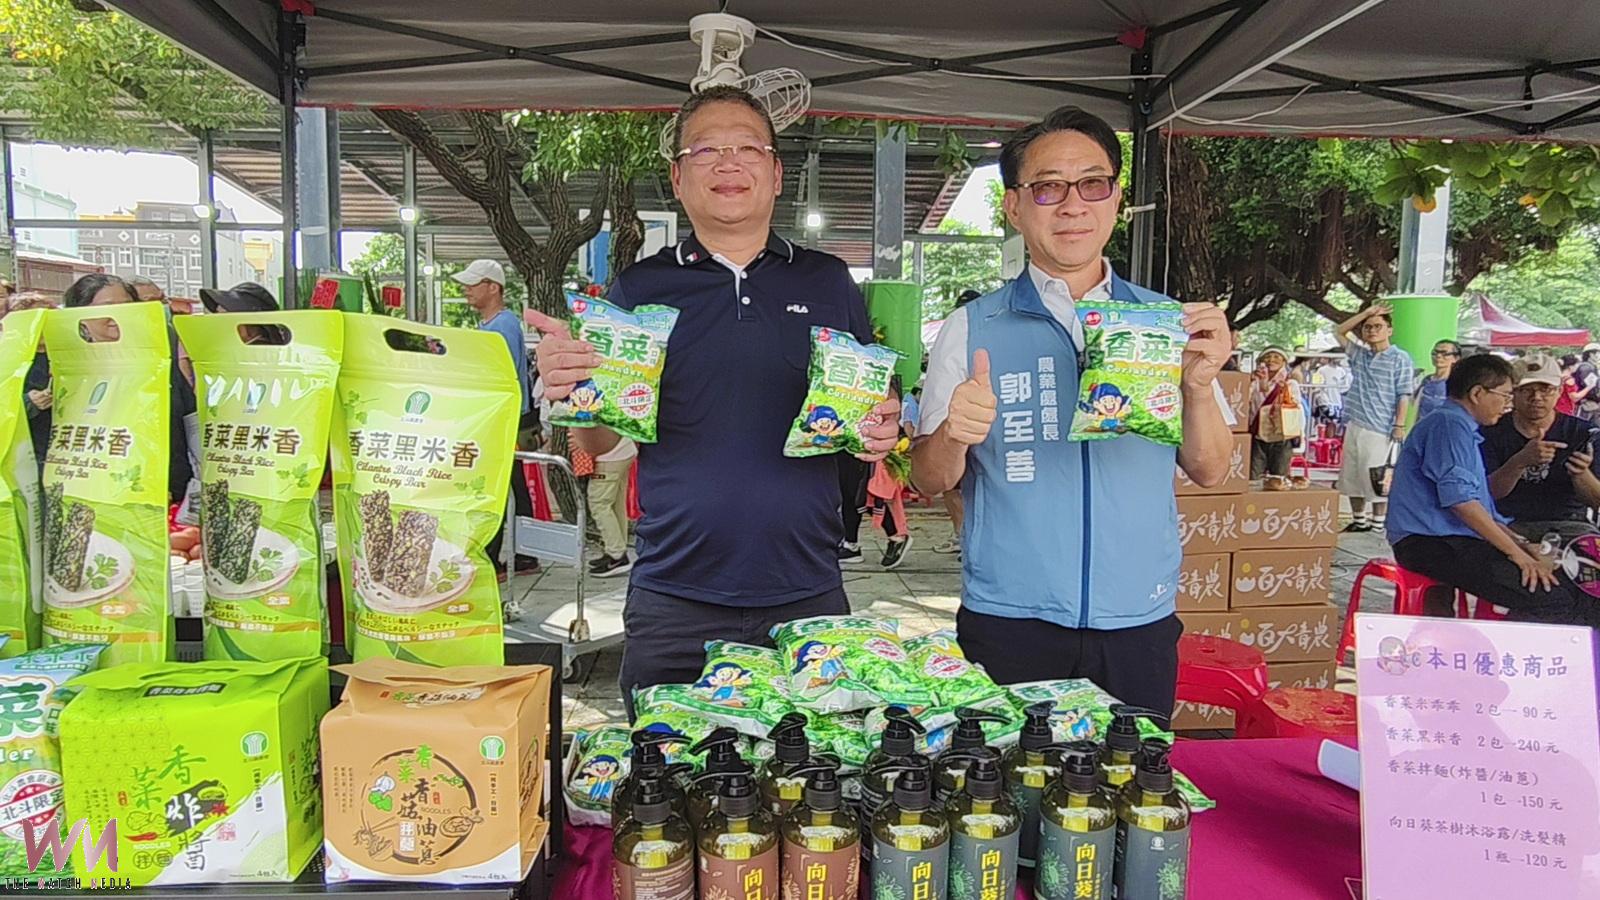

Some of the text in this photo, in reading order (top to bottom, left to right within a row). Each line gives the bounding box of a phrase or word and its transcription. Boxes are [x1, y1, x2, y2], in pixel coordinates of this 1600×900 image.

[786, 304, 809, 313] FILA
[1105, 331, 1171, 363] 香菜
[826, 354, 888, 393] 香菜
[999, 372, 1035, 482] 郭至善
[404, 477, 426, 488] Bar
[426, 468, 452, 480] Rice
[1427, 647, 1567, 679] 本日優惠商品
[1384, 695, 1461, 713] 香菜米乖乖
[1386, 727, 1462, 746] 香菜黑米香
[397, 744, 432, 784] 香菜
[1, 788, 63, 821] 北斗限定
[420, 807, 451, 815] NOODLES
